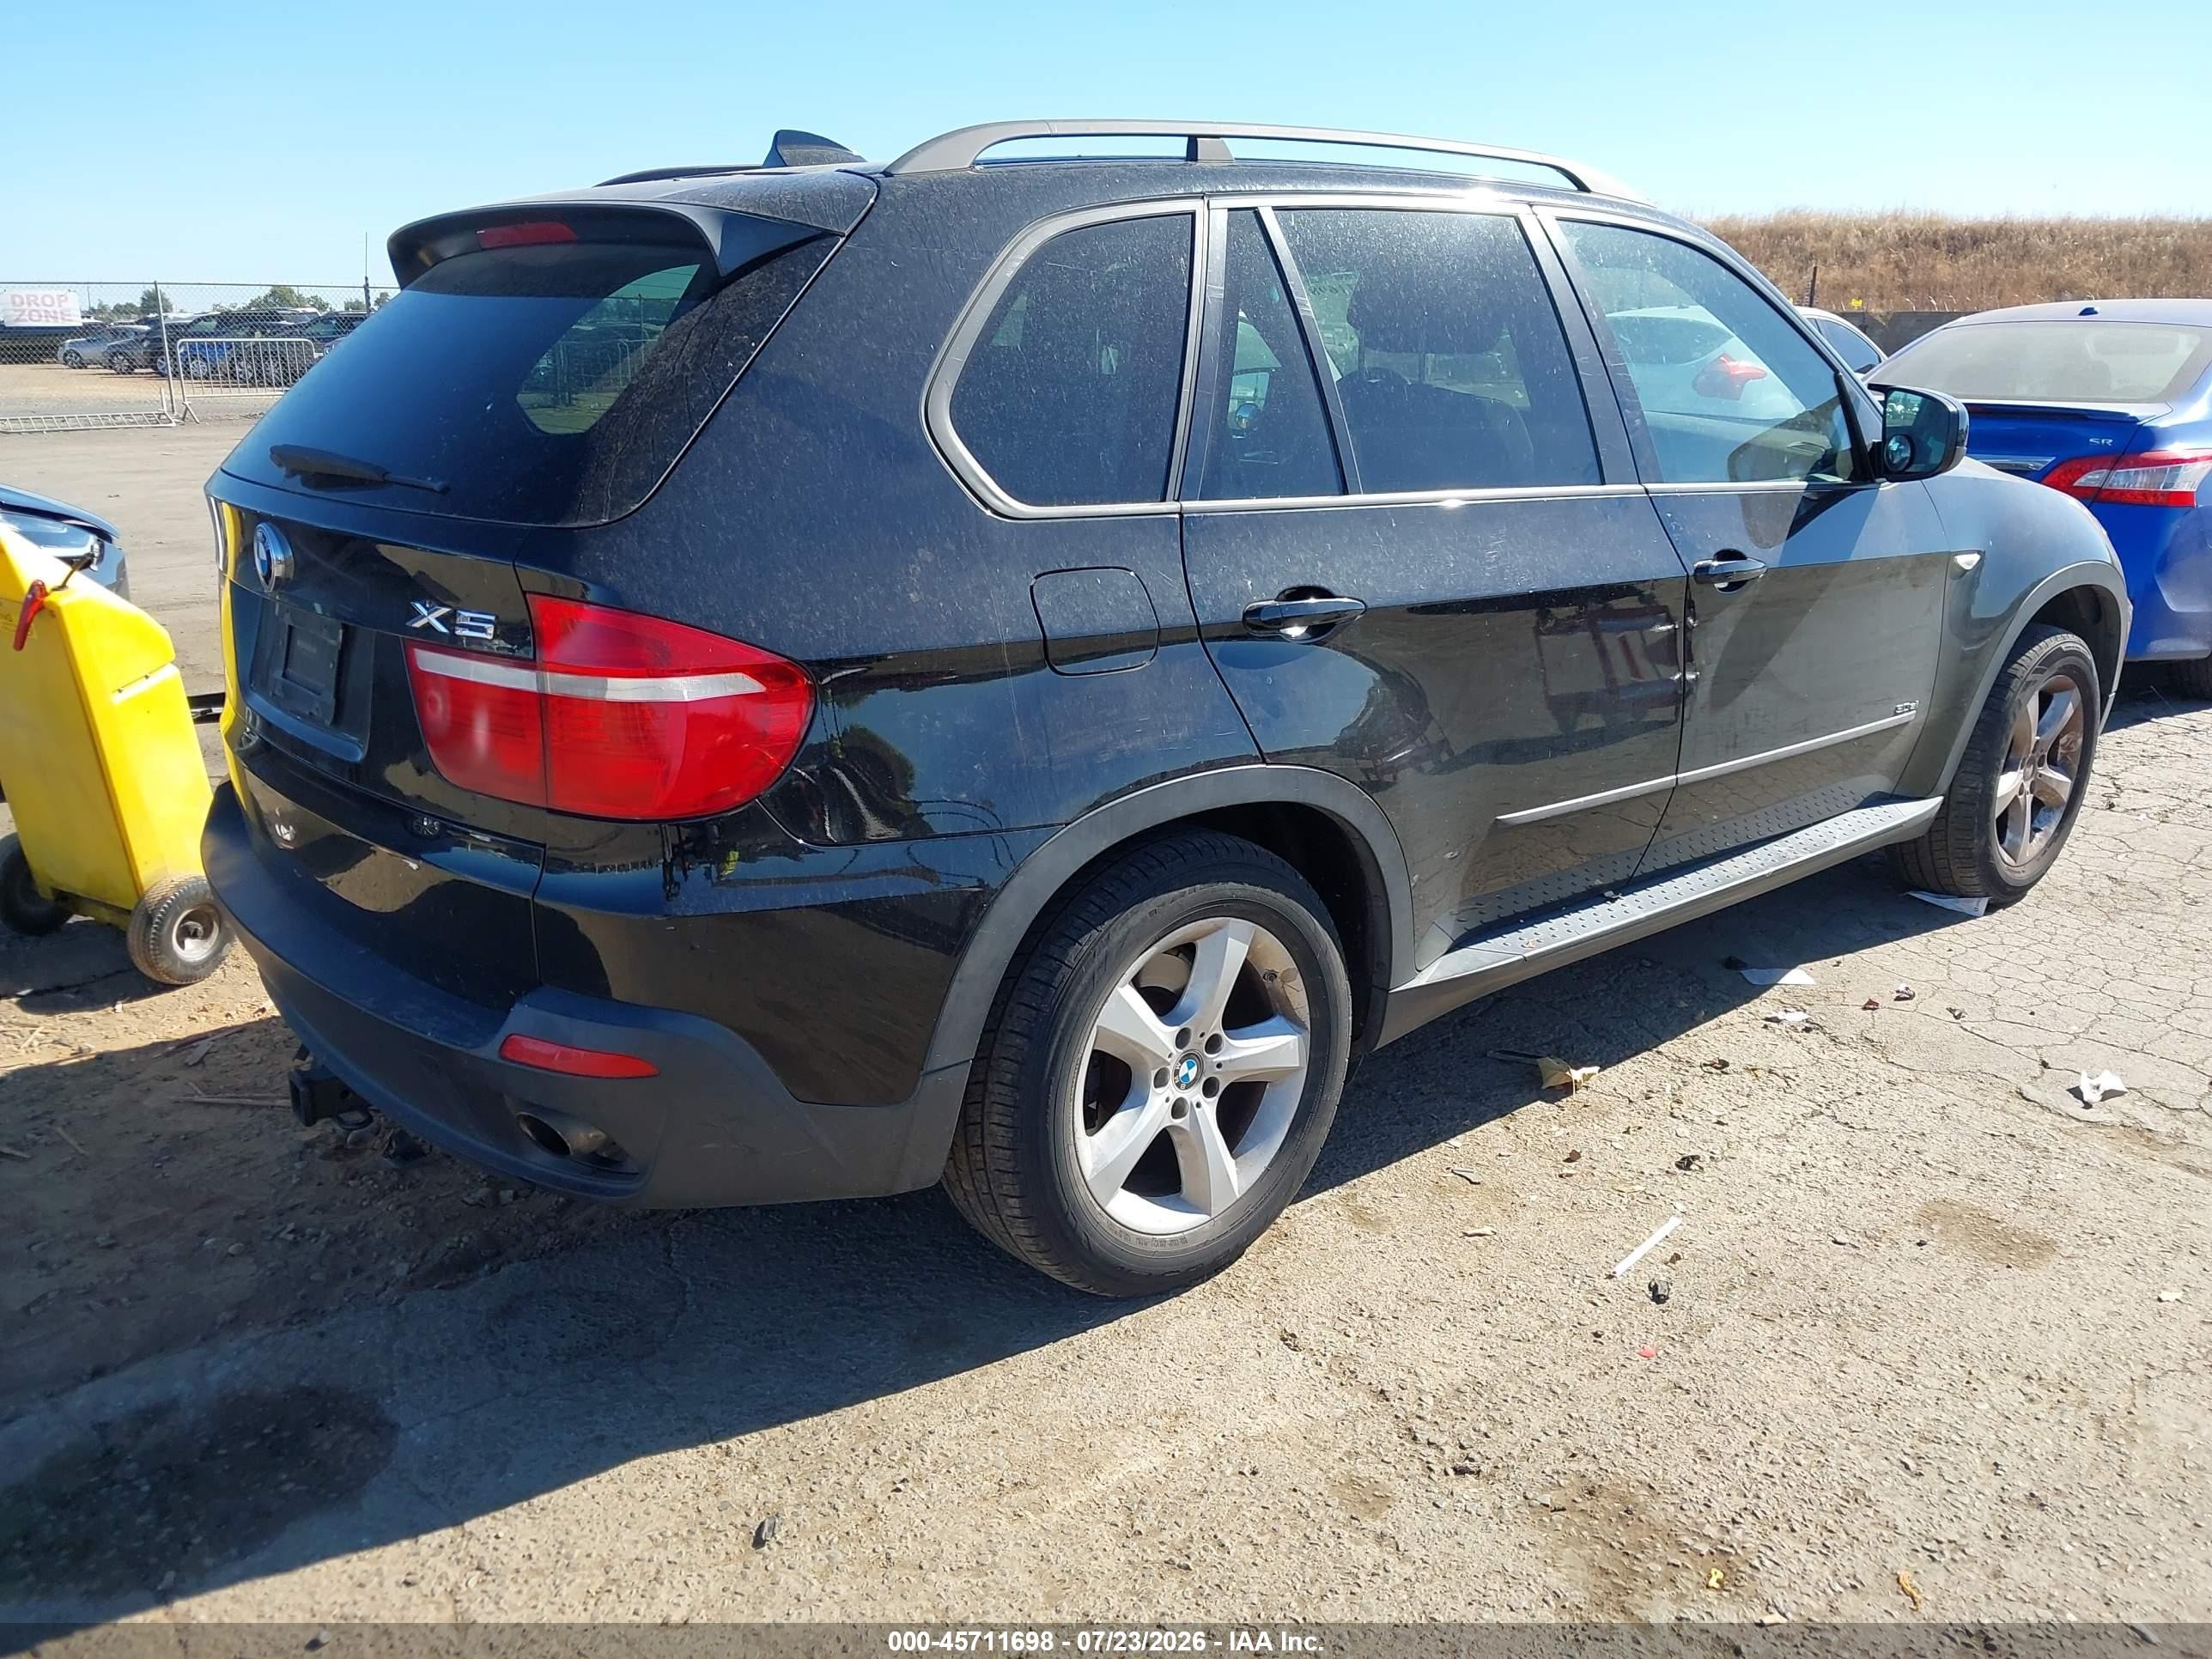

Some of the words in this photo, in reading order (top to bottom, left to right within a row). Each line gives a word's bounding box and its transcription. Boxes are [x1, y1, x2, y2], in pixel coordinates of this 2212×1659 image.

[10, 294, 69, 307] DROP
[13, 308, 75, 323] ZONE
[2088, 438, 2113, 447] SR
[405, 601, 495, 640] X5
